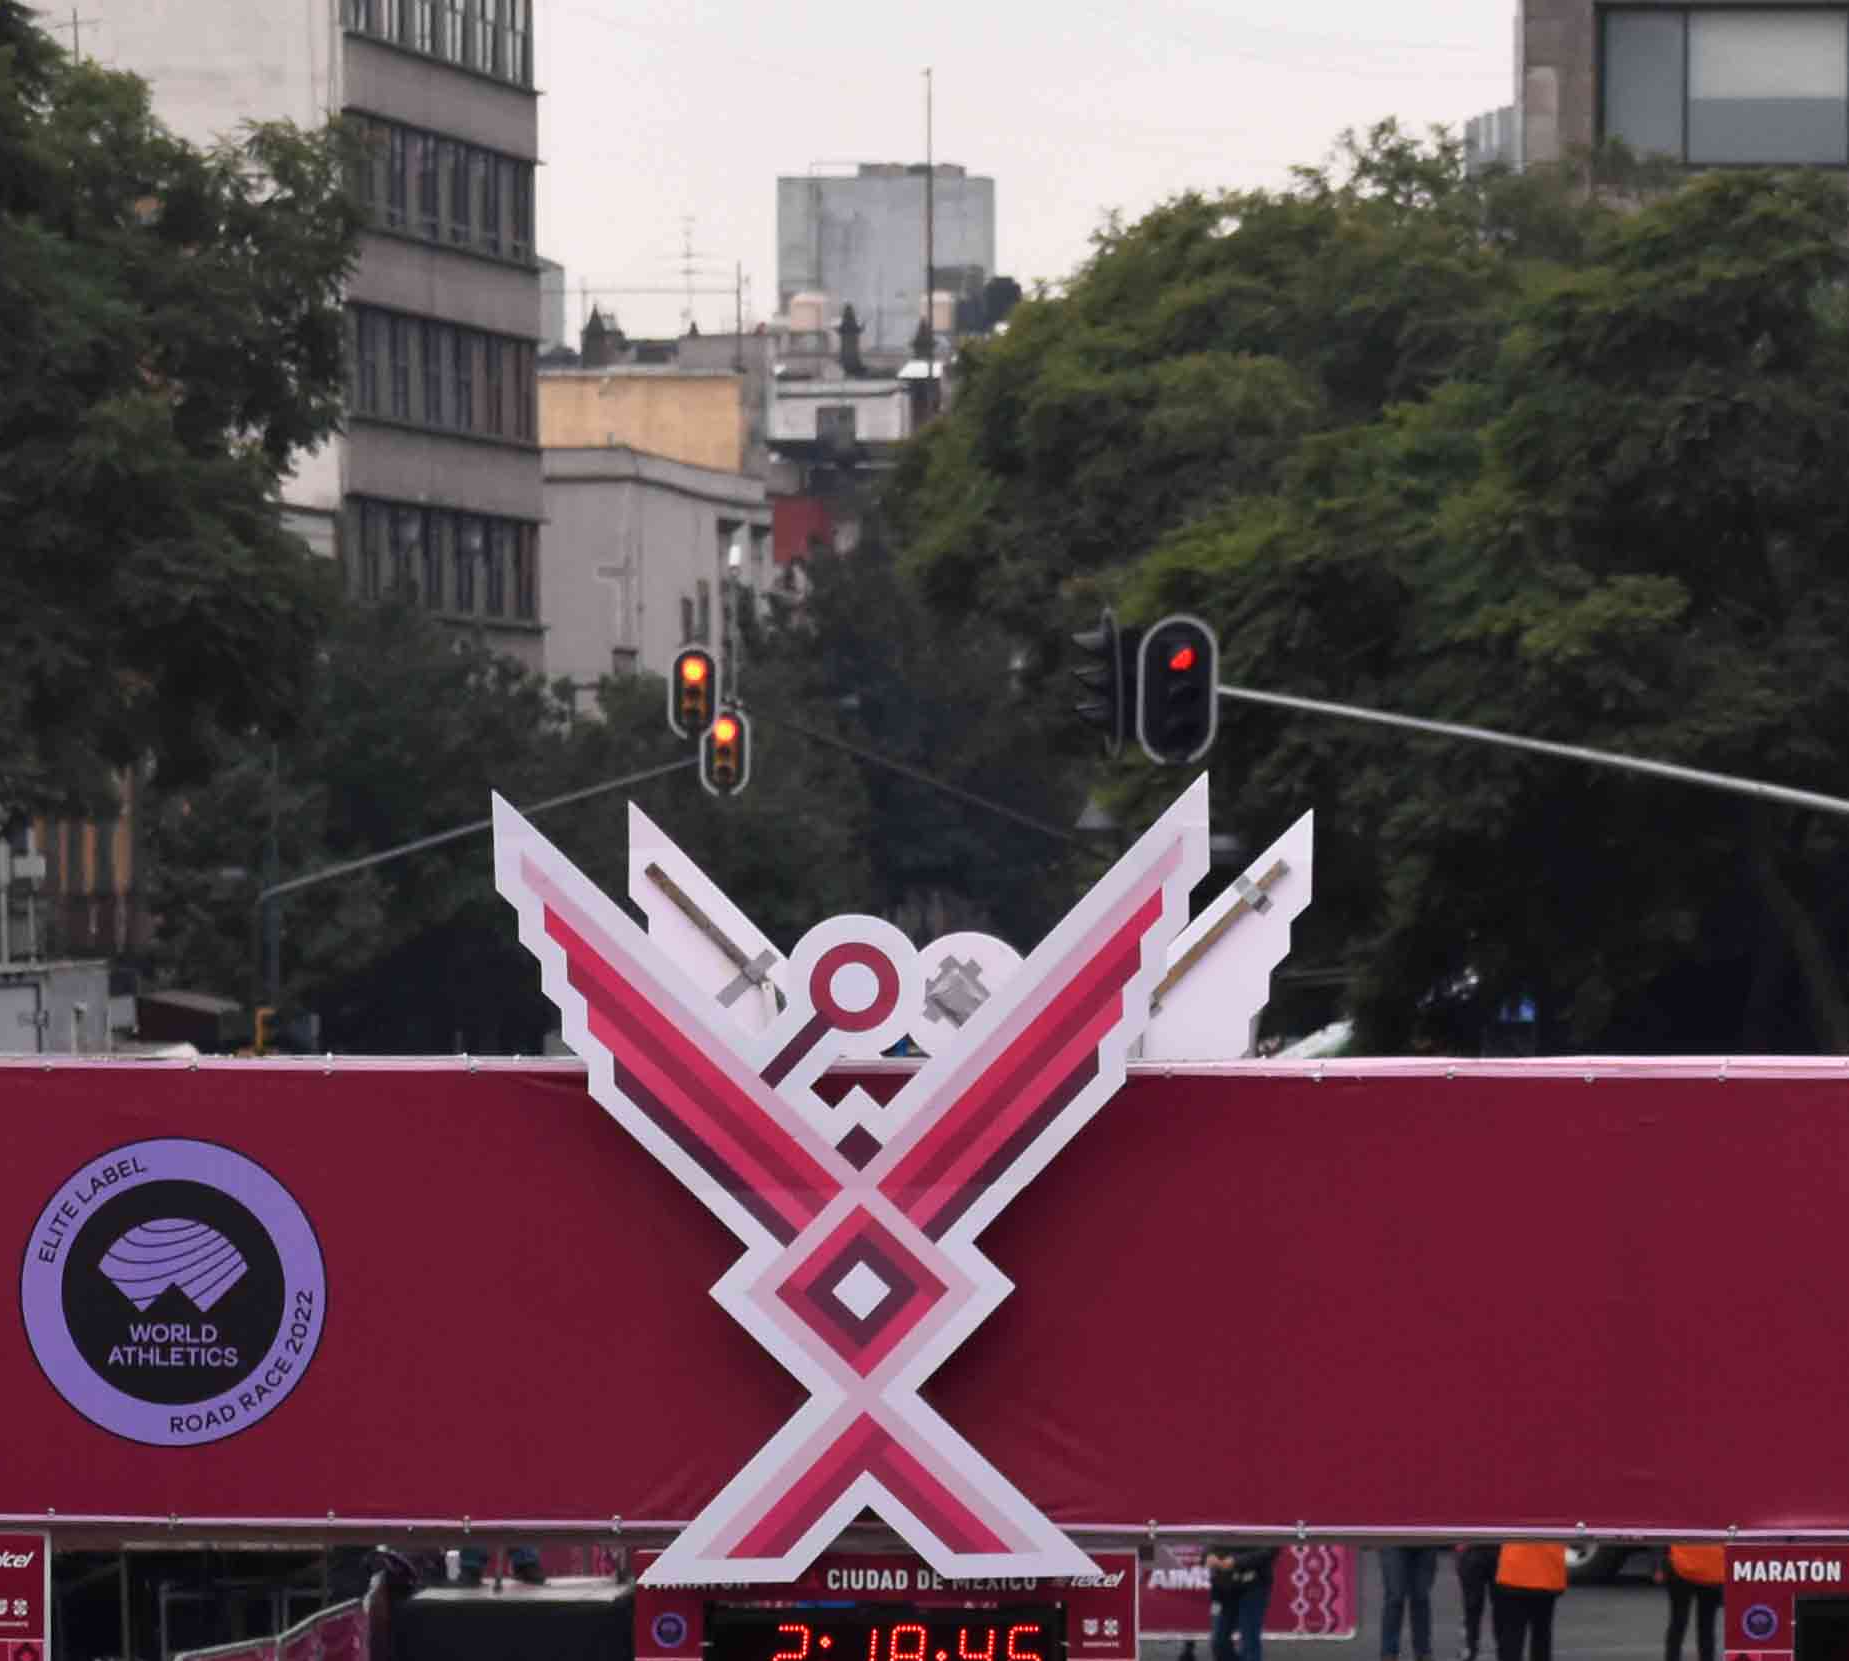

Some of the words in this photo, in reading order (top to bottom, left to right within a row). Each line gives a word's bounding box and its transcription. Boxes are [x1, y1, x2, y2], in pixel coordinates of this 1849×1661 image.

[39, 1202, 78, 1264] ELITE
[75, 1156, 148, 1203] LABEL
[129, 1323, 218, 1343] WORLD
[107, 1346, 239, 1367] ATHLETICS
[169, 1404, 237, 1433] ROAD
[239, 1357, 293, 1411] RACE
[285, 1289, 313, 1355] 2022
[827, 1569, 909, 1590] CIUDAD
[916, 1570, 943, 1590] DE
